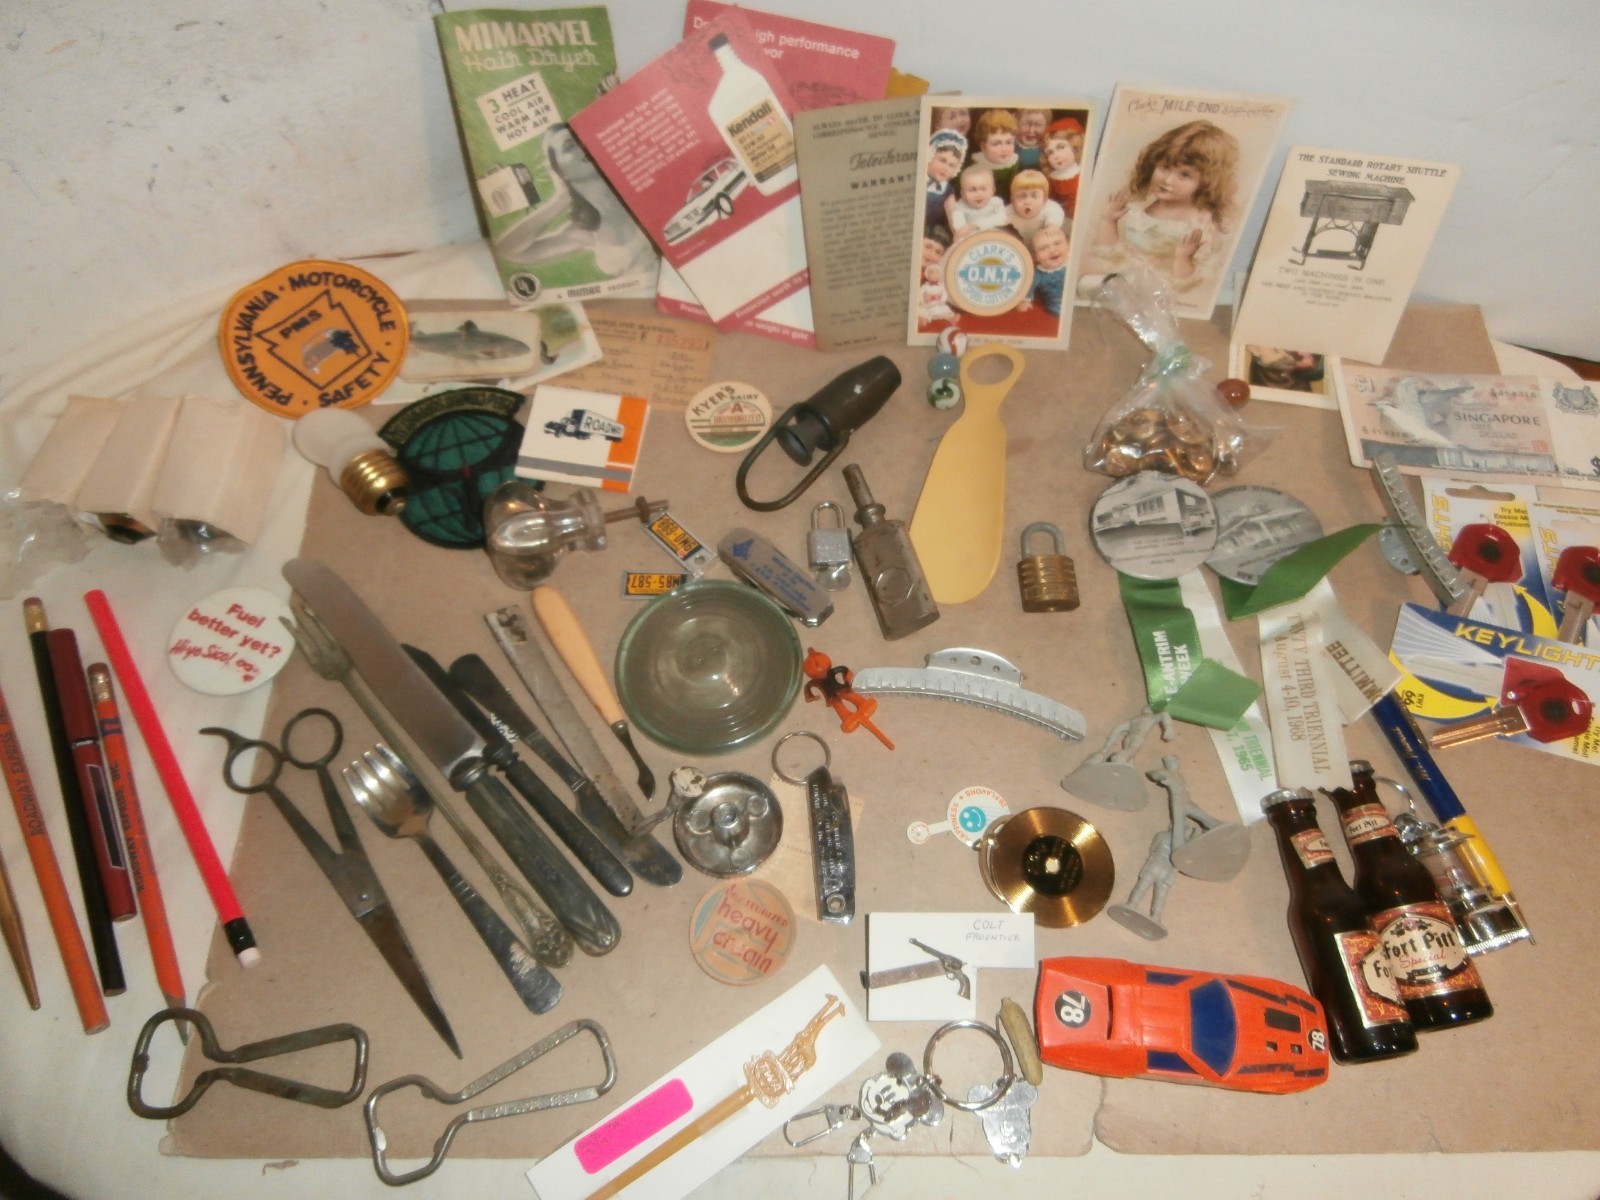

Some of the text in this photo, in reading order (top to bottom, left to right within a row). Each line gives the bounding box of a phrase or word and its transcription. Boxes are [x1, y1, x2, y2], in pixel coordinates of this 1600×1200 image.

[455, 20, 597, 53] MIMARVEL
[779, 33, 860, 59] performance
[463, 48, 599, 73] Hair Dryer
[487, 78, 537, 114] 3 HEAT
[494, 96, 544, 124] COOL AIR
[496, 104, 551, 134] WARM AIR
[506, 115, 549, 141] HOT AIR
[727, 103, 772, 138] Kendall
[850, 172, 917, 190] WARRANT
[1298, 153, 1448, 178] THE STANDARD ROTARY SHUTTLE
[1326, 168, 1406, 185] SEWING MACHINE
[968, 244, 1015, 264] CLARK'S
[967, 266, 1012, 283] O.N.T.
[1301, 268, 1350, 283] MACHINES
[288, 271, 396, 333] MOTORCYCLE
[233, 290, 294, 406] PENNSYLVANIA
[317, 352, 391, 408] SAFETY
[692, 385, 735, 417] KYER'S
[1453, 410, 1541, 428] SINGAPORE
[226, 603, 266, 628] Fuel
[187, 608, 281, 658] better yet?
[1275, 636, 1306, 742] August 4-10, 1968
[1295, 659, 1316, 699] THIRD
[4, 730, 25, 775] EXPRESS
[1303, 702, 1331, 774] TRIENNIAL
[1232, 744, 1254, 772] 1965
[1243, 734, 1273, 782] TRIENNIAL
[17, 778, 46, 836] ROADWAY
[950, 801, 971, 841] HAPPINESS
[717, 896, 779, 954] heavy
[972, 919, 1005, 931] COLT
[713, 931, 773, 974] cram
[1060, 993, 1087, 1024] 78
[1311, 1029, 1326, 1051] 78
